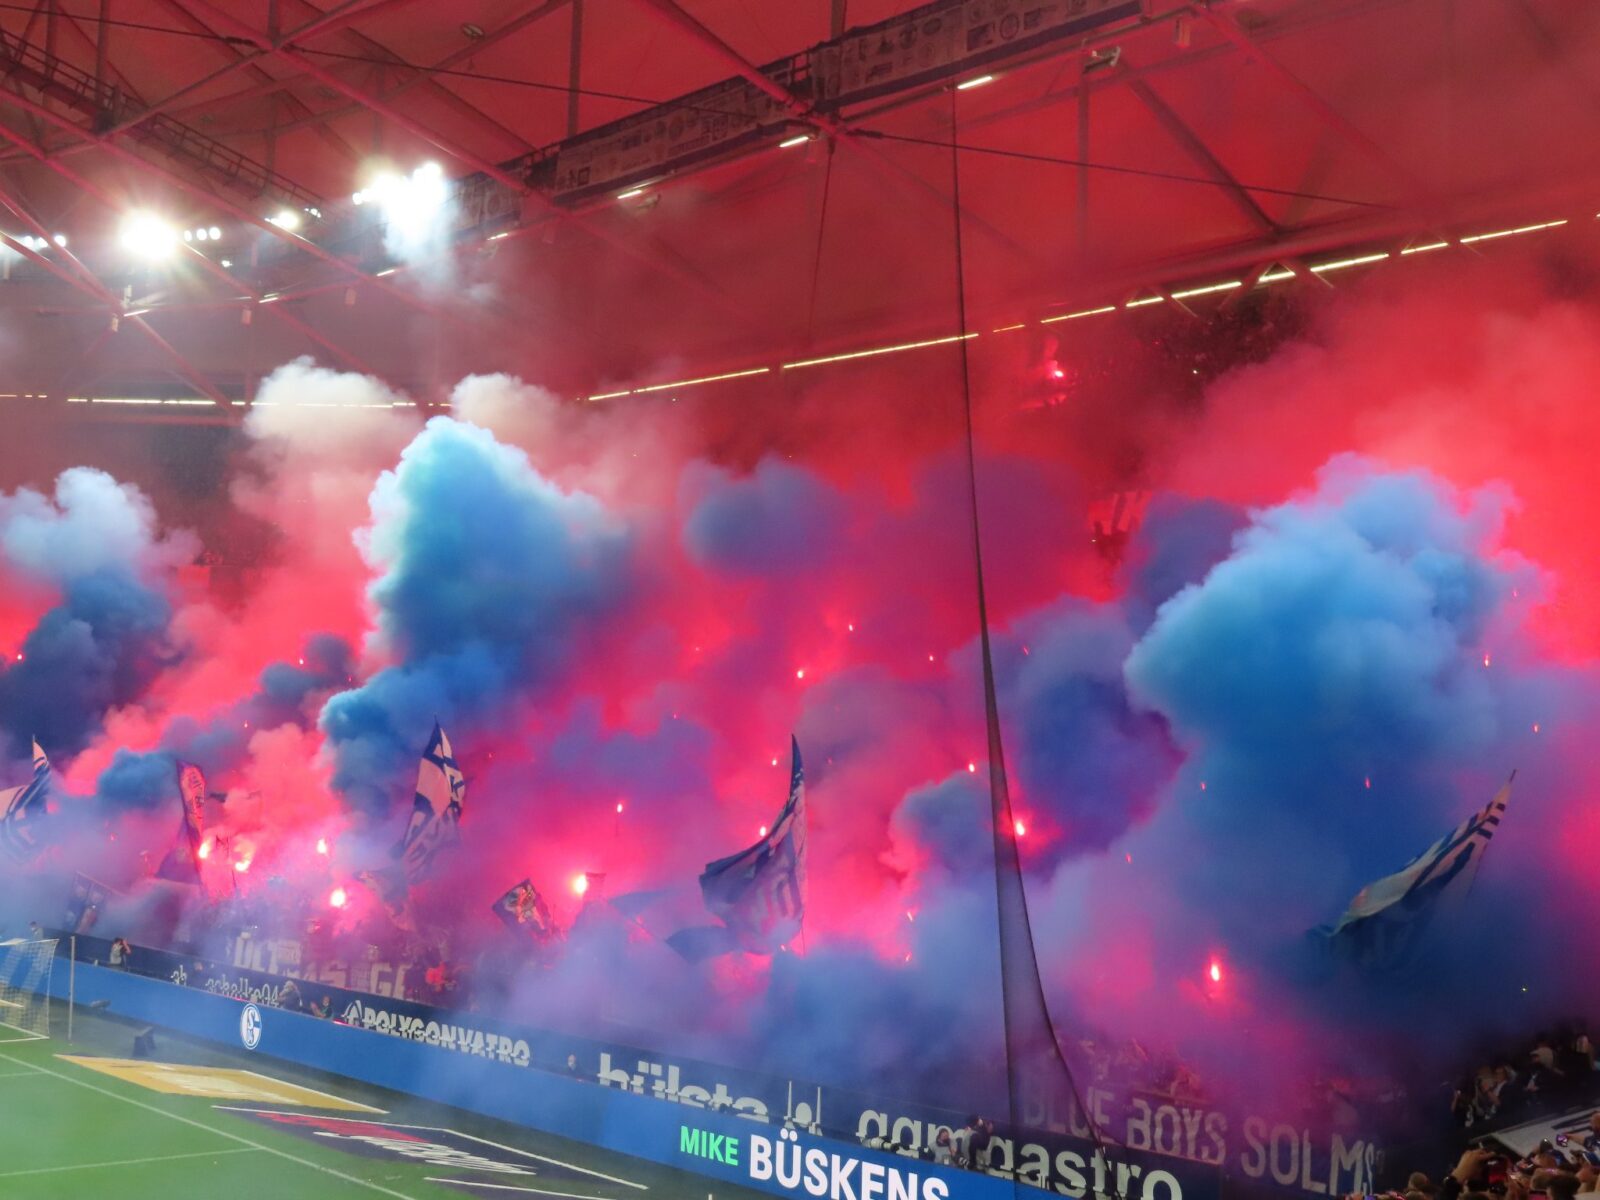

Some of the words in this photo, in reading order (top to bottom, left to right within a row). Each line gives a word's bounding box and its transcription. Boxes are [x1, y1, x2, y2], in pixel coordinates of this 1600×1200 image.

[679, 1125, 739, 1166] MIKE
[750, 1127, 949, 1200] BÜSKENS
[1126, 1097, 1229, 1165] BOYS
